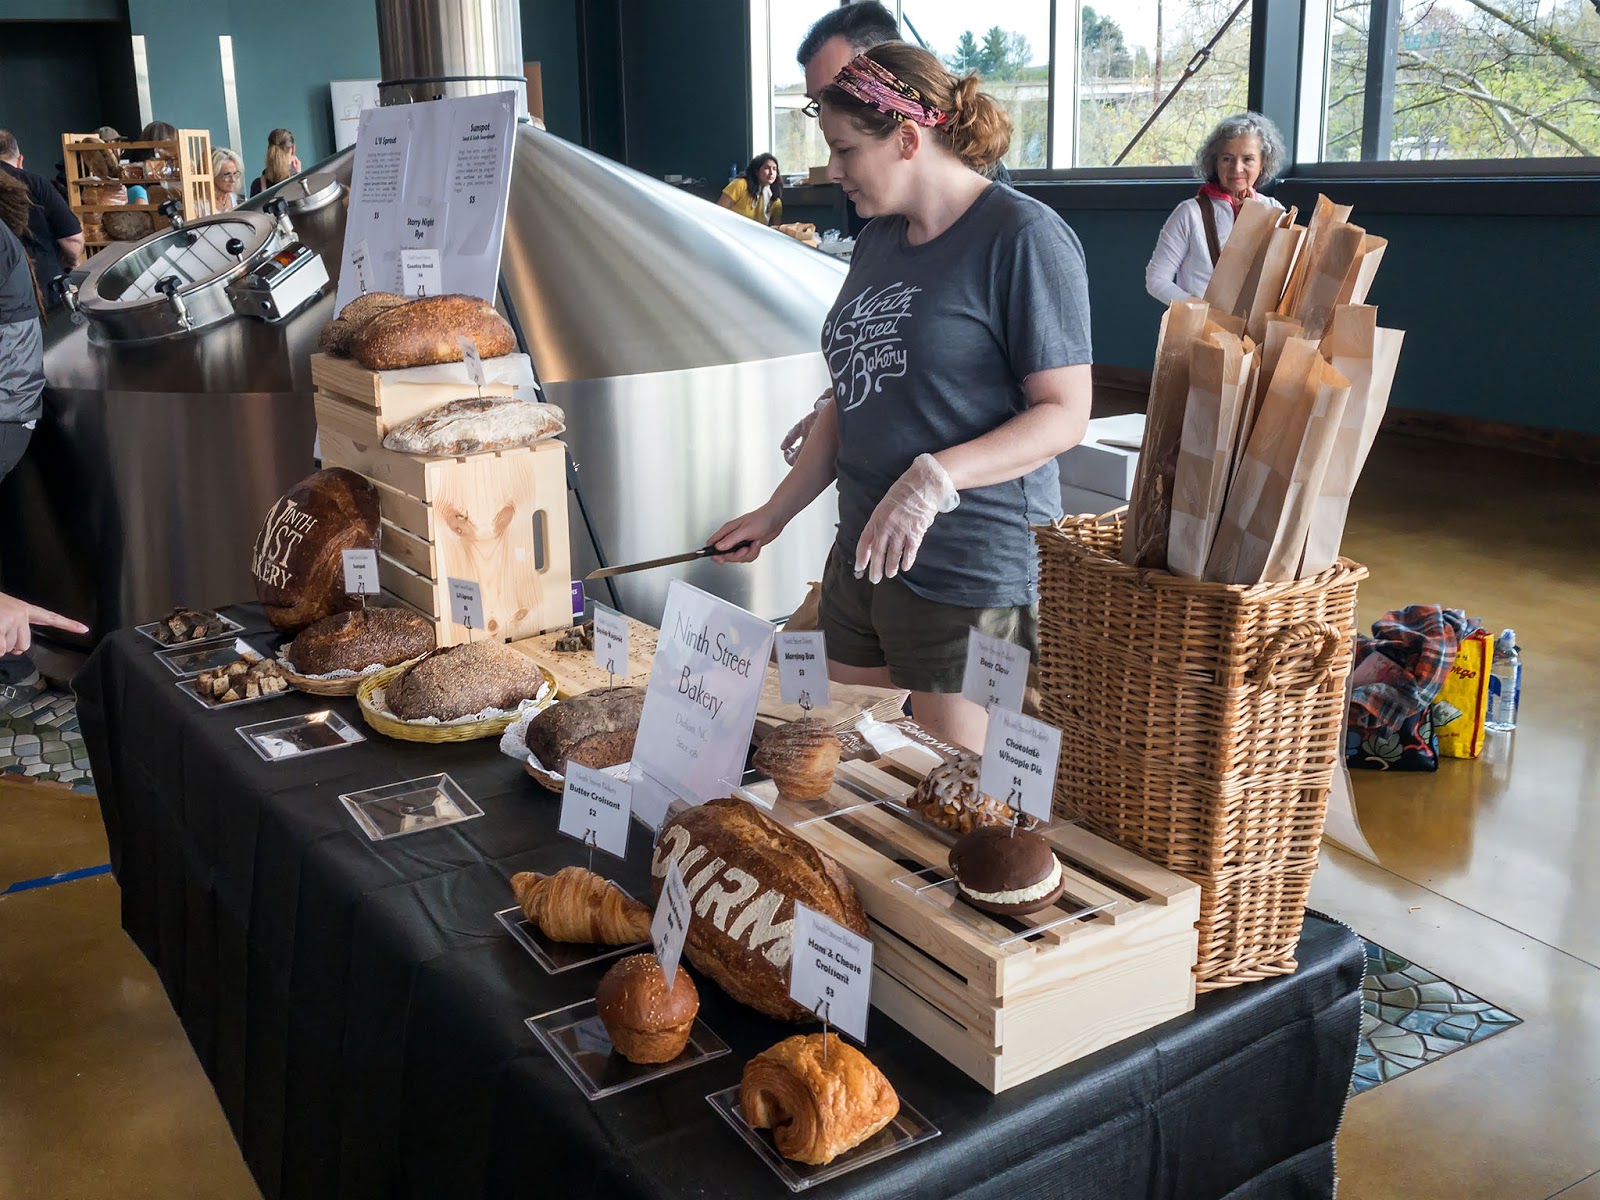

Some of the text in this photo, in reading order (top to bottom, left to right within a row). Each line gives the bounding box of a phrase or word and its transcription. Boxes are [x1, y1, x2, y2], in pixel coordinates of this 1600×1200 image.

[470, 123, 490, 133] Sunspot
[382, 137, 397, 146] Sprout
[469, 196, 476, 204] $5
[407, 218, 434, 227] Starry Night
[414, 230, 424, 239] Rye
[829, 317, 902, 379] Street
[843, 345, 907, 411] Bakery
[268, 525, 303, 568] ST
[673, 611, 752, 678] Ninth Street
[785, 652, 815, 661] Morning Bun
[980, 657, 1010, 675] Bear Claw
[989, 678, 995, 687] $3
[678, 665, 723, 720] Bakery
[1006, 738, 1040, 758] Chocolate
[999, 750, 1042, 776] Whoopie Pie
[1013, 776, 1021, 786] $4
[569, 783, 620, 810] Butter Croissant
[589, 808, 597, 817] $2
[808, 938, 862, 975] Ham & Cheese
[815, 958, 849, 985] Croissant
[826, 986, 834, 998] $3
